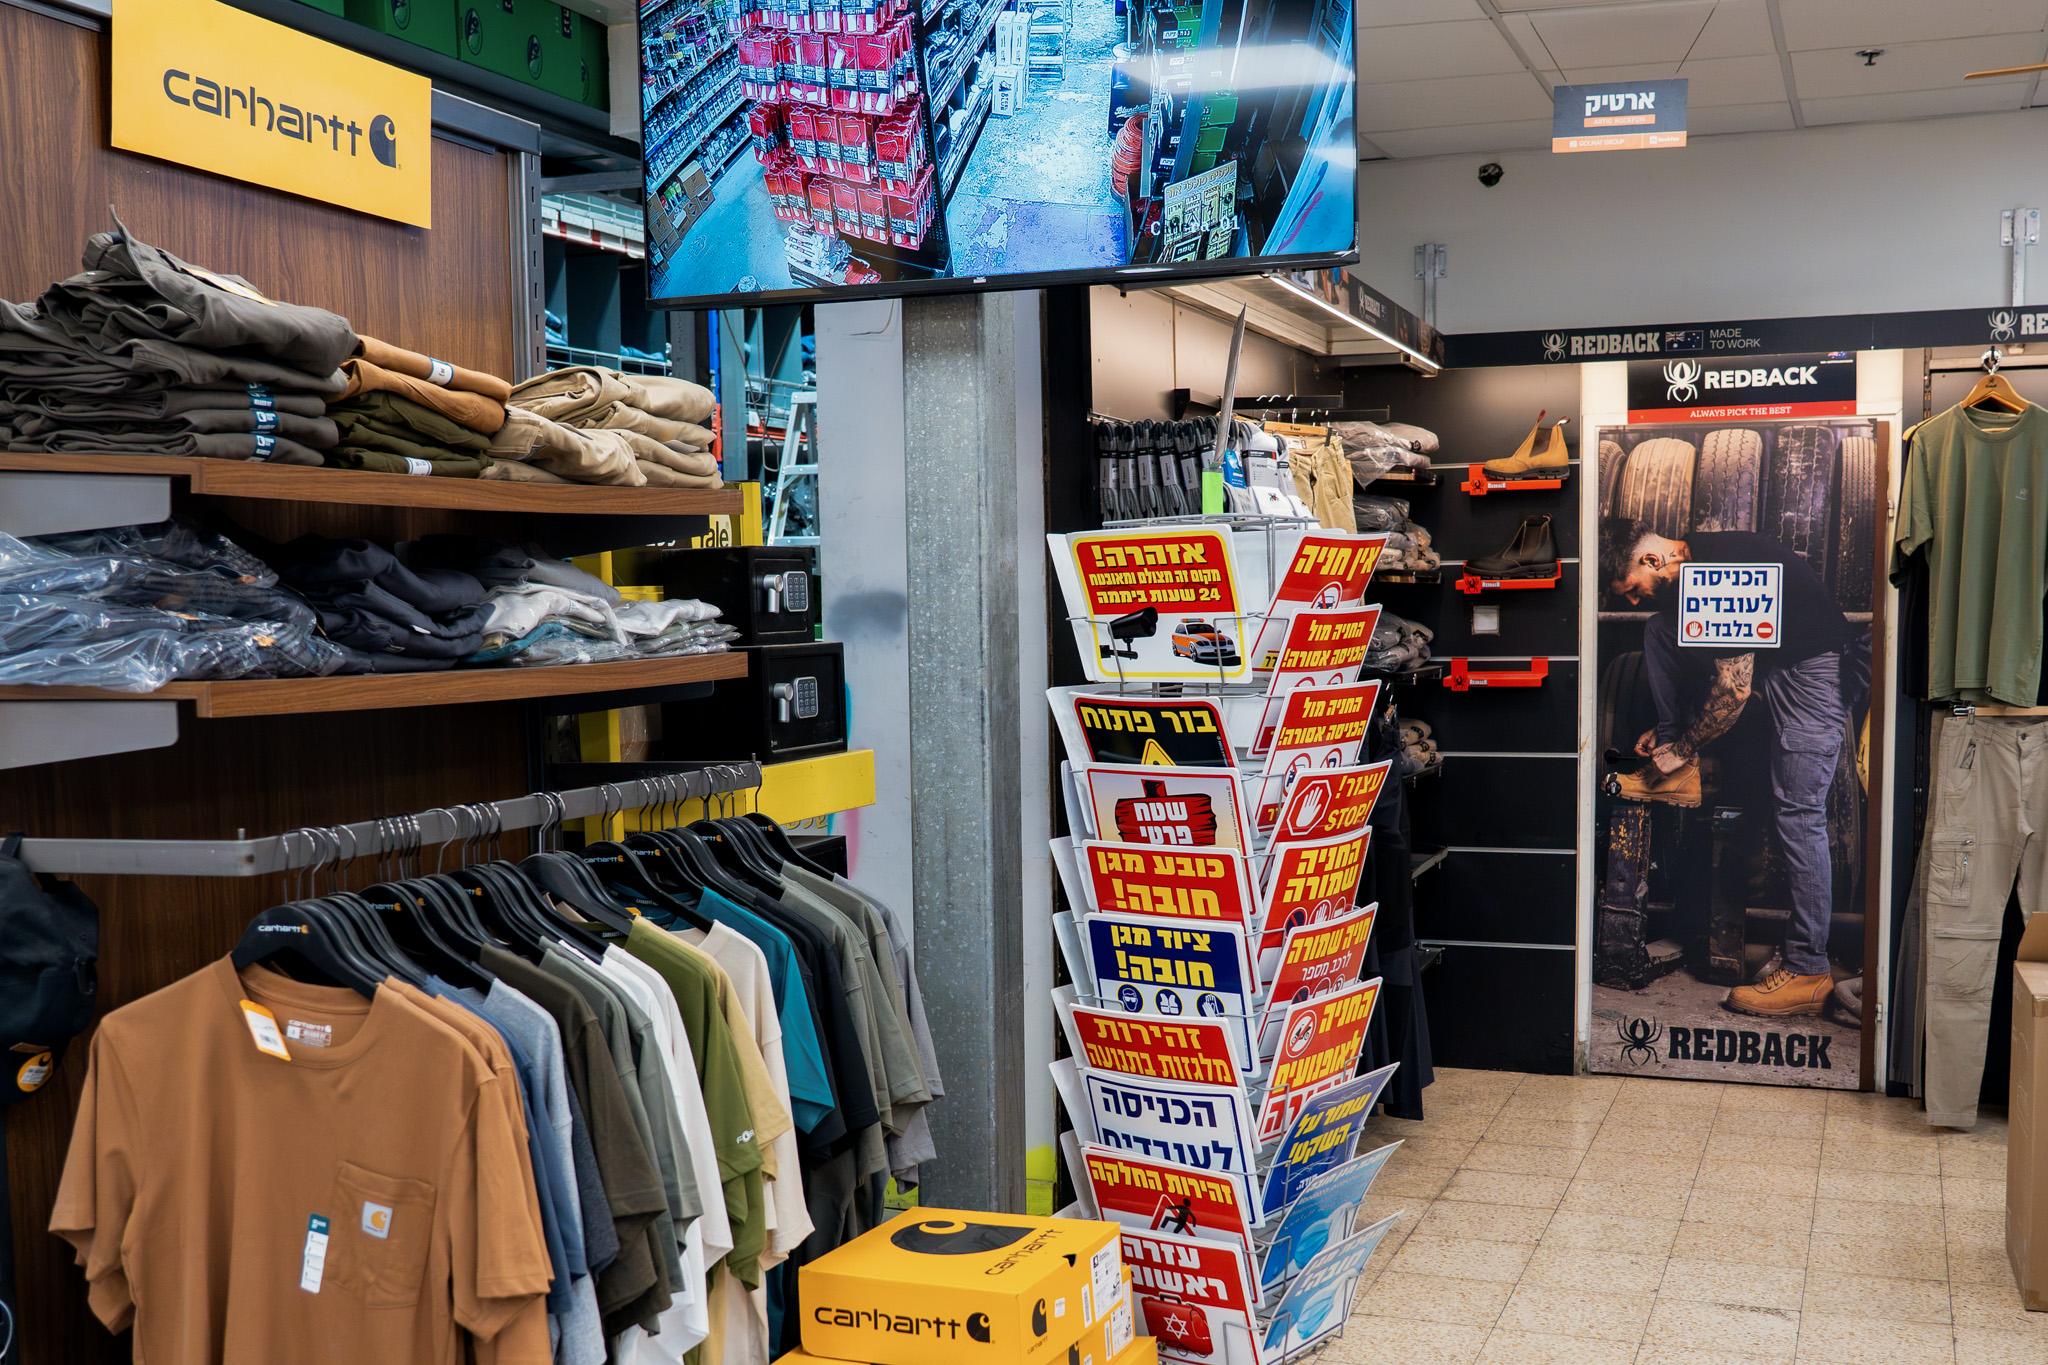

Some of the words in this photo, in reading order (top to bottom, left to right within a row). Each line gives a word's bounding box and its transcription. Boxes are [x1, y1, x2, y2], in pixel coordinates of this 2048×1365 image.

[163, 69, 363, 157] carhartt
[1585, 92, 1655, 116] ארטיק
[1570, 332, 1660, 356] REDBACK
[1709, 328, 1742, 339] MADE
[1709, 340, 1725, 350] TO
[1726, 338, 1761, 350] WORK
[1704, 366, 1818, 390] REDBACK
[1690, 408, 1726, 418] ALWAYS
[1727, 408, 1748, 417] PICK
[1749, 407, 1768, 416] THE
[1768, 406, 1792, 415] BEST
[1091, 543, 1208, 568] אזהרה!
[1294, 544, 1353, 576] חניה
[1345, 546, 1381, 582] אין
[1088, 571, 1136, 587] ומאובטח
[1139, 568, 1174, 585] מצולם
[1175, 571, 1189, 583] זה
[1192, 569, 1222, 585] מקום
[1692, 570, 1768, 587] הכניסה
[1096, 590, 1147, 604] ביממה
[1149, 589, 1196, 603] שעות
[1199, 587, 1222, 602] 24
[1686, 594, 1773, 613] לעובדים
[1307, 620, 1332, 641] מול
[1332, 621, 1366, 640] החניה
[1705, 620, 1754, 638] בלבד!
[1281, 648, 1331, 668] אסורה!
[1329, 645, 1367, 666] הכניסה
[1302, 697, 1327, 718] מול
[1326, 696, 1364, 716] החניה
[1079, 706, 1156, 733] פתוח
[1160, 710, 1218, 733] בור
[1326, 720, 1367, 741] הכניסה
[1278, 726, 1327, 746] אסורה!
[1335, 771, 1385, 800] עצור!
[1133, 801, 1189, 822] שטח
[1324, 799, 1373, 832] STOP!
[1139, 825, 1194, 845] פרטי
[1096, 851, 1146, 875] מגן
[1152, 855, 1226, 879] כובע
[1296, 838, 1363, 875] החניה
[1282, 863, 1360, 903] שמורה
[1111, 878, 1221, 917] חובה!
[1110, 925, 1152, 947] מגן
[1156, 929, 1212, 952] ציוד
[1342, 916, 1372, 951] חניה
[1286, 929, 1344, 965] שמורה
[1115, 950, 1215, 988] חובה!
[1302, 961, 1328, 981] מספר
[1330, 952, 1352, 973] לרכב
[1319, 988, 1376, 1035] החניה
[1093, 1018, 1202, 1050] זהירות
[1086, 1042, 1156, 1076] בתנועה
[1668, 1026, 1832, 1069] REDBACK
[1157, 1052, 1233, 1083] מלגזות
[1271, 1029, 1362, 1095] לאופנועים
[1100, 1085, 1218, 1128] הכניסה
[1323, 1091, 1373, 1126] שמור
[1294, 1111, 1325, 1138] על
[1088, 1159, 1164, 1192] החלקה
[1164, 1172, 1234, 1205] זהירות
[985, 1229, 1064, 1277] carhartt
[1121, 1235, 1201, 1269] עזרה
[1131, 1265, 1229, 1300] ראשונ
[815, 1305, 961, 1340] carhartt
